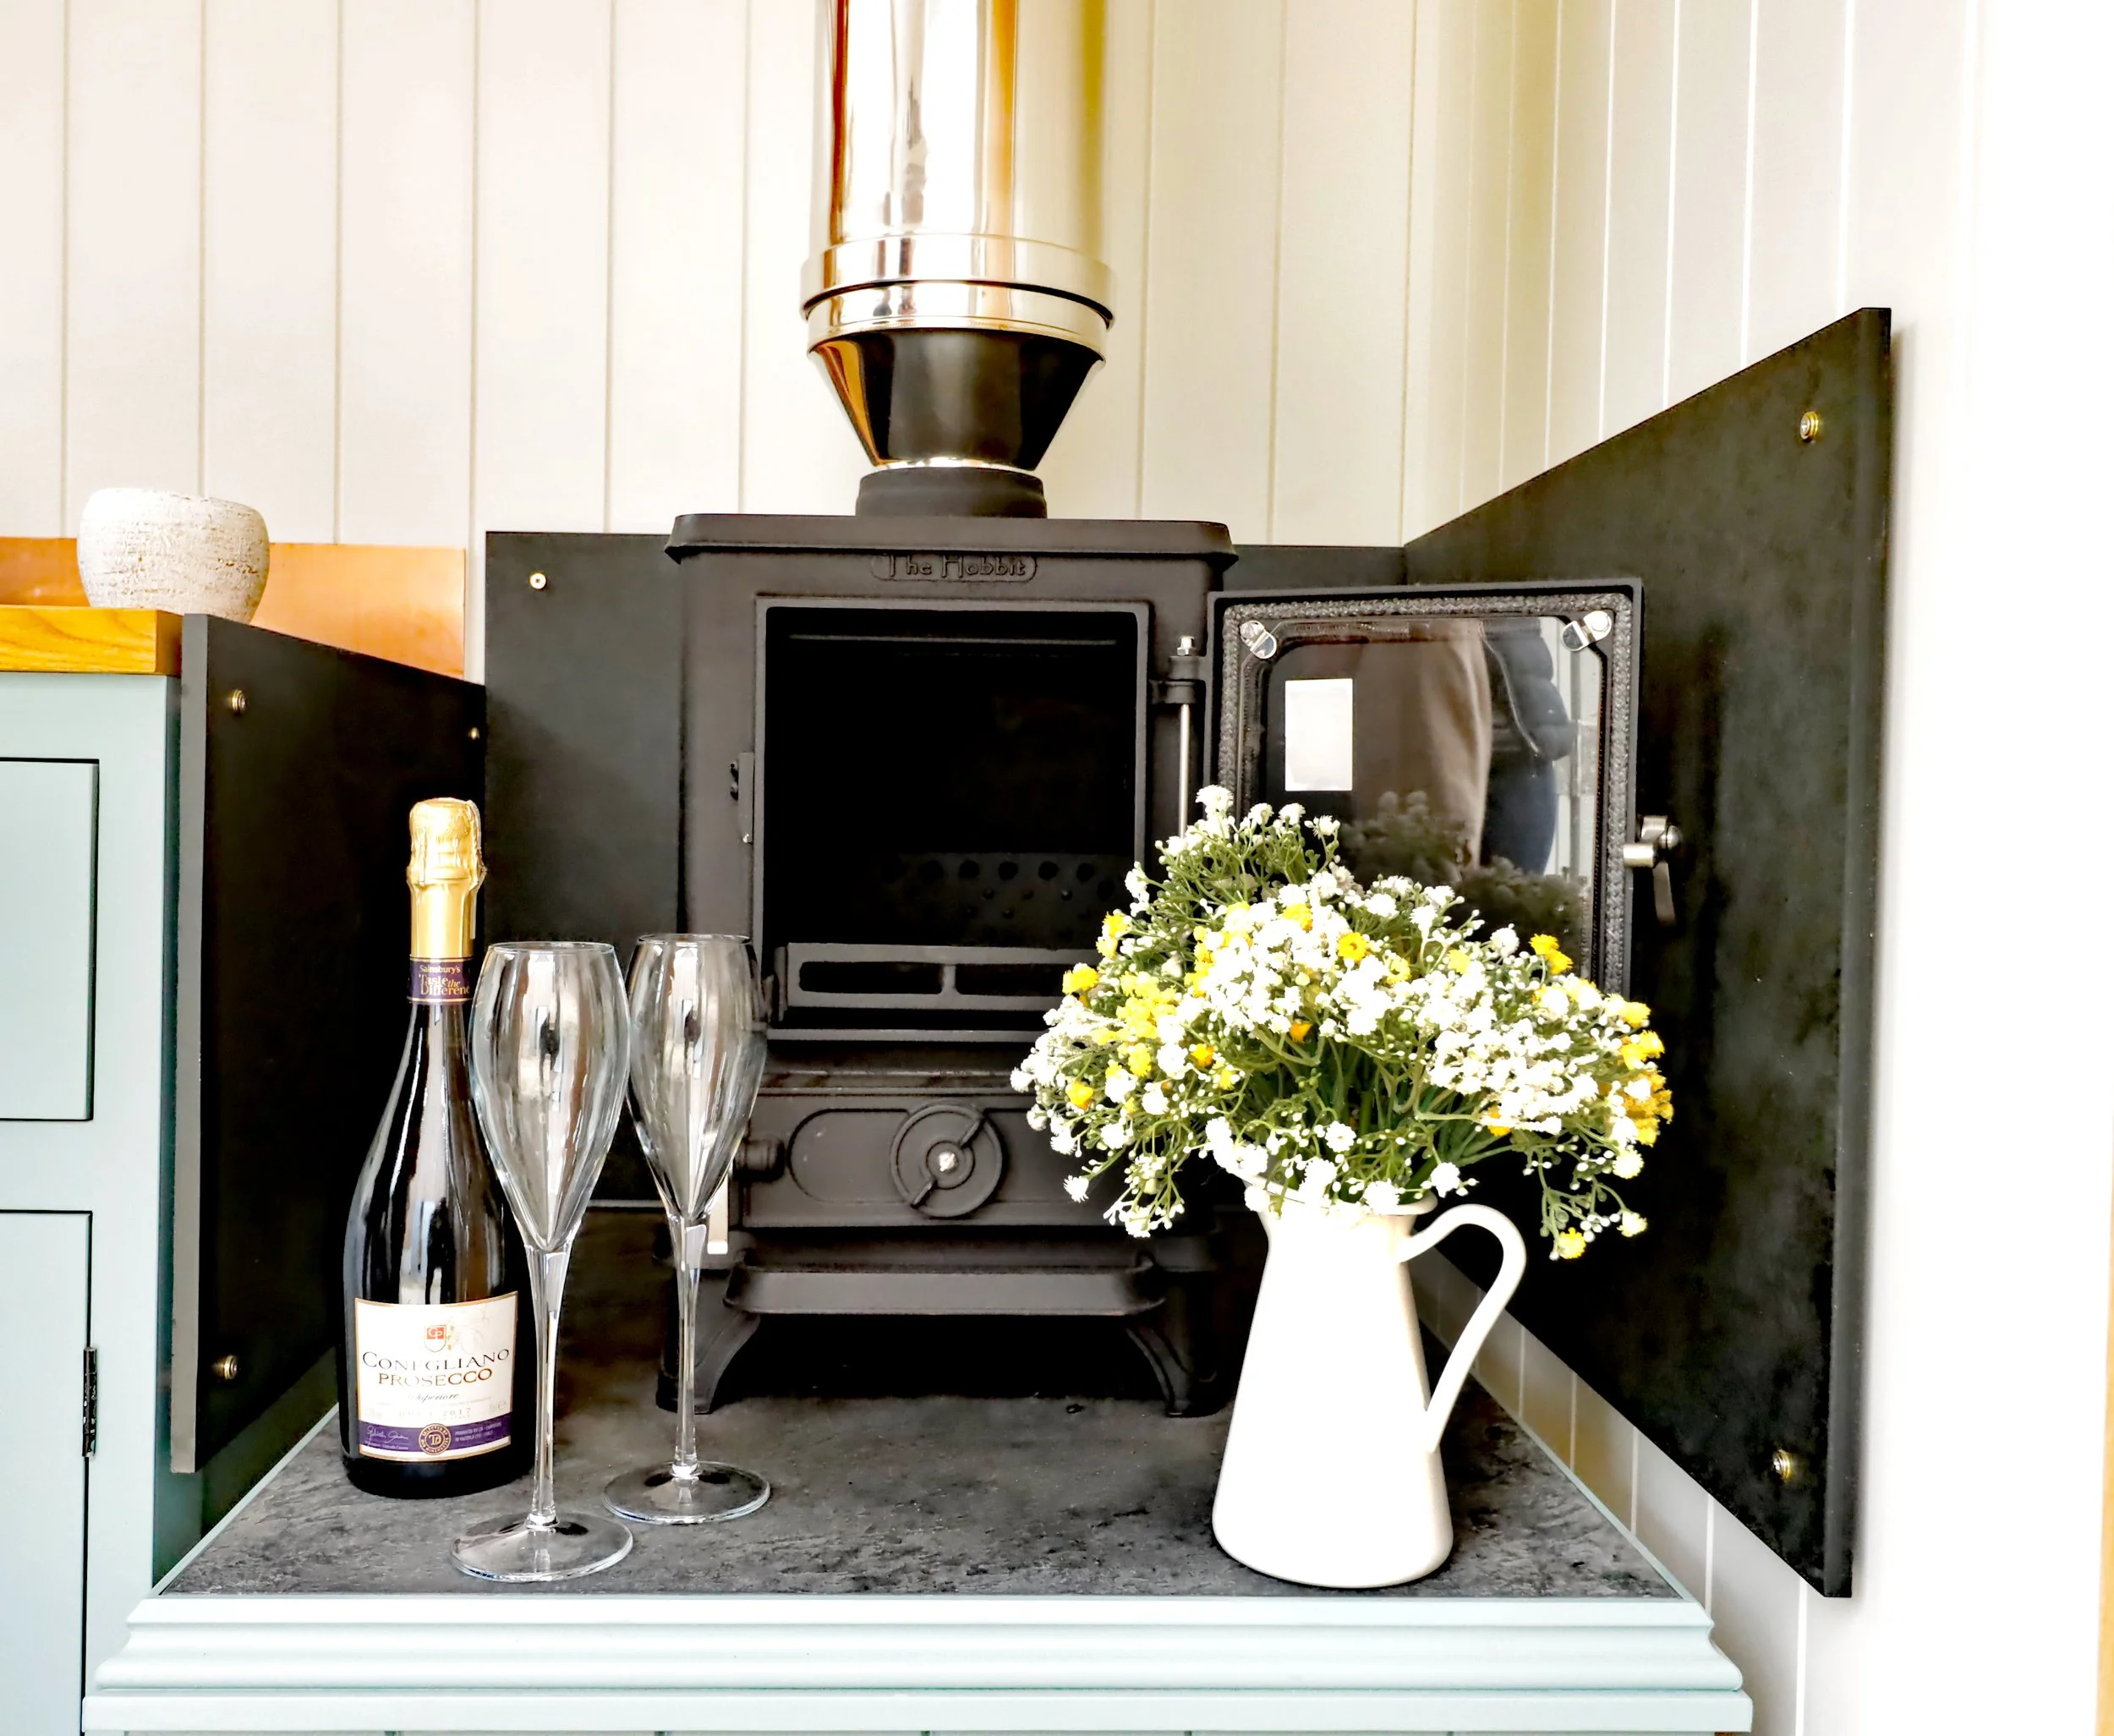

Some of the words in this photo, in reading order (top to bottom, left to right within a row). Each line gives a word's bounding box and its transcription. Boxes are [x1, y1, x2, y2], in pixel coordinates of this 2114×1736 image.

[889, 554, 933, 578] The
[941, 555, 1026, 578] Hobbit
[419, 965, 461, 974] Sainsbury's
[419, 974, 449, 985] Taste
[447, 979, 461, 988] the
[420, 983, 470, 995] Differenc
[378, 1367, 493, 1387] PROSECCO
